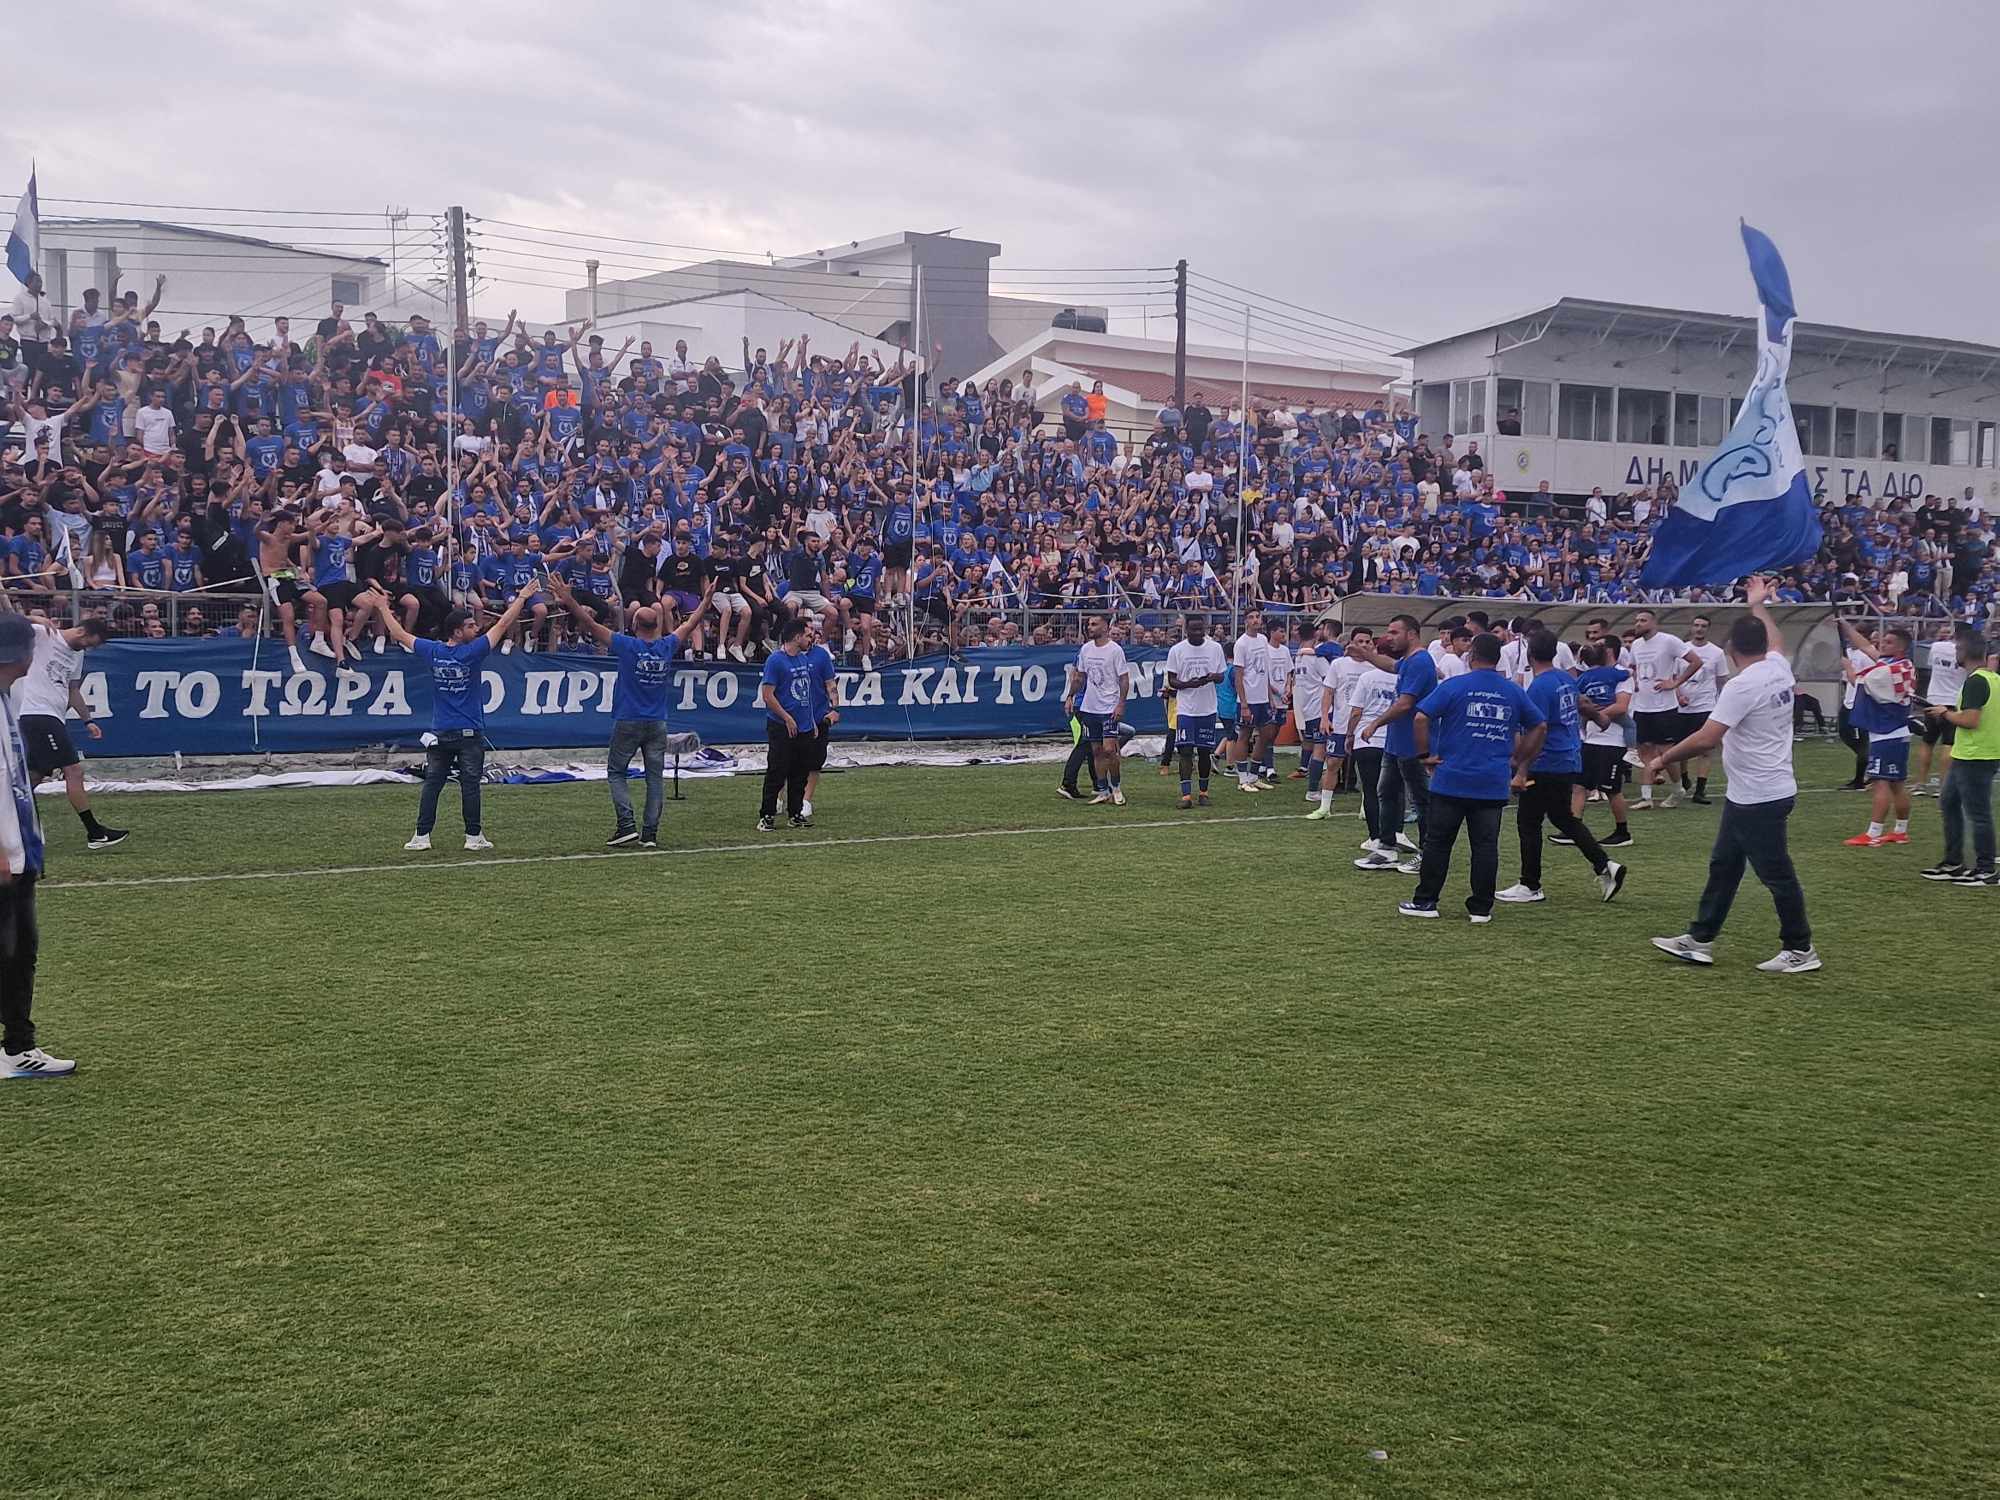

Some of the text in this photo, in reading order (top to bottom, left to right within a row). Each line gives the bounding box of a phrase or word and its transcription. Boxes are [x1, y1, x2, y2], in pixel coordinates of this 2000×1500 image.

[135, 670, 221, 719] ΤΟ
[241, 670, 413, 716] ΤΩΡΑ
[520, 670, 619, 715] ΠΡΙ
[673, 669, 739, 710] ΤΟ
[897, 665, 981, 706] ΚΑΙ
[993, 664, 1048, 705] ΤΟ
